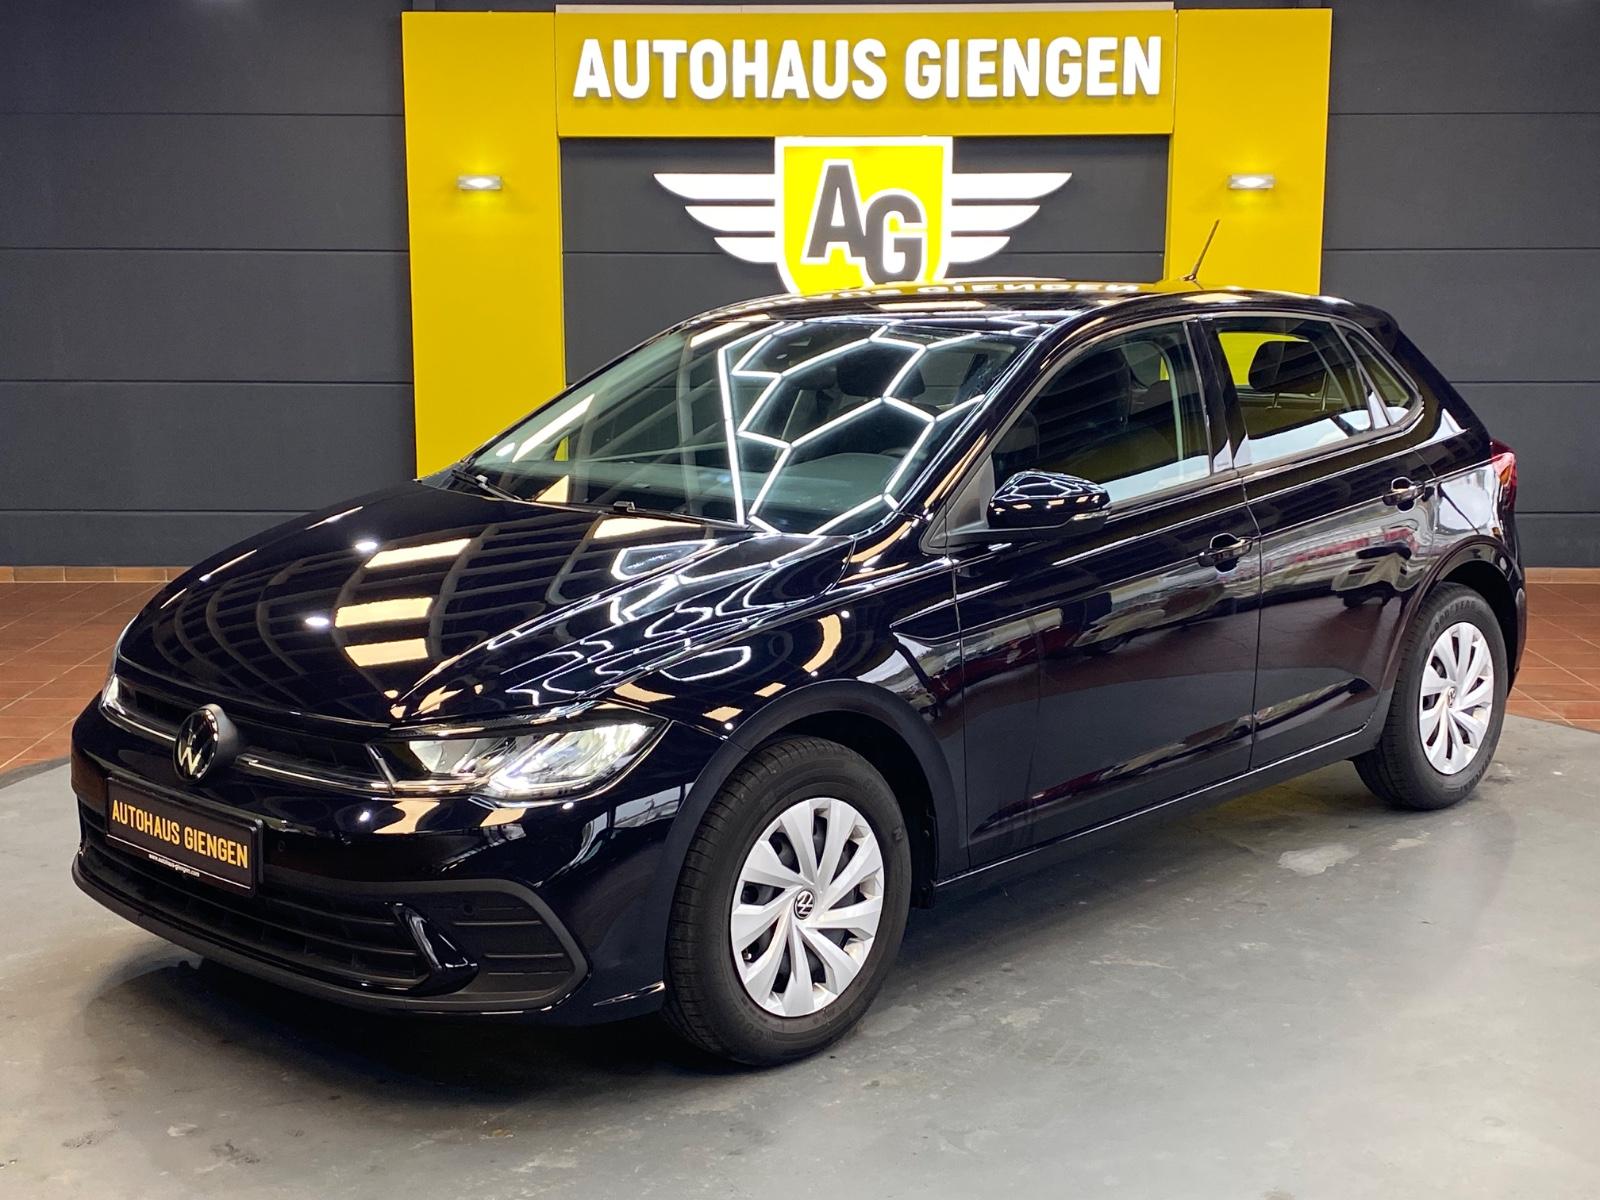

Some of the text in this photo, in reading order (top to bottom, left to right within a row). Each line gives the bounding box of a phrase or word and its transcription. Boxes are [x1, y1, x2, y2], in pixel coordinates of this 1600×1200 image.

[573, 35, 1162, 101] AUTOHAUS GIENGEN
[805, 163, 923, 285] AG
[112, 799, 249, 869] AUTOHAUS GIENGEN
